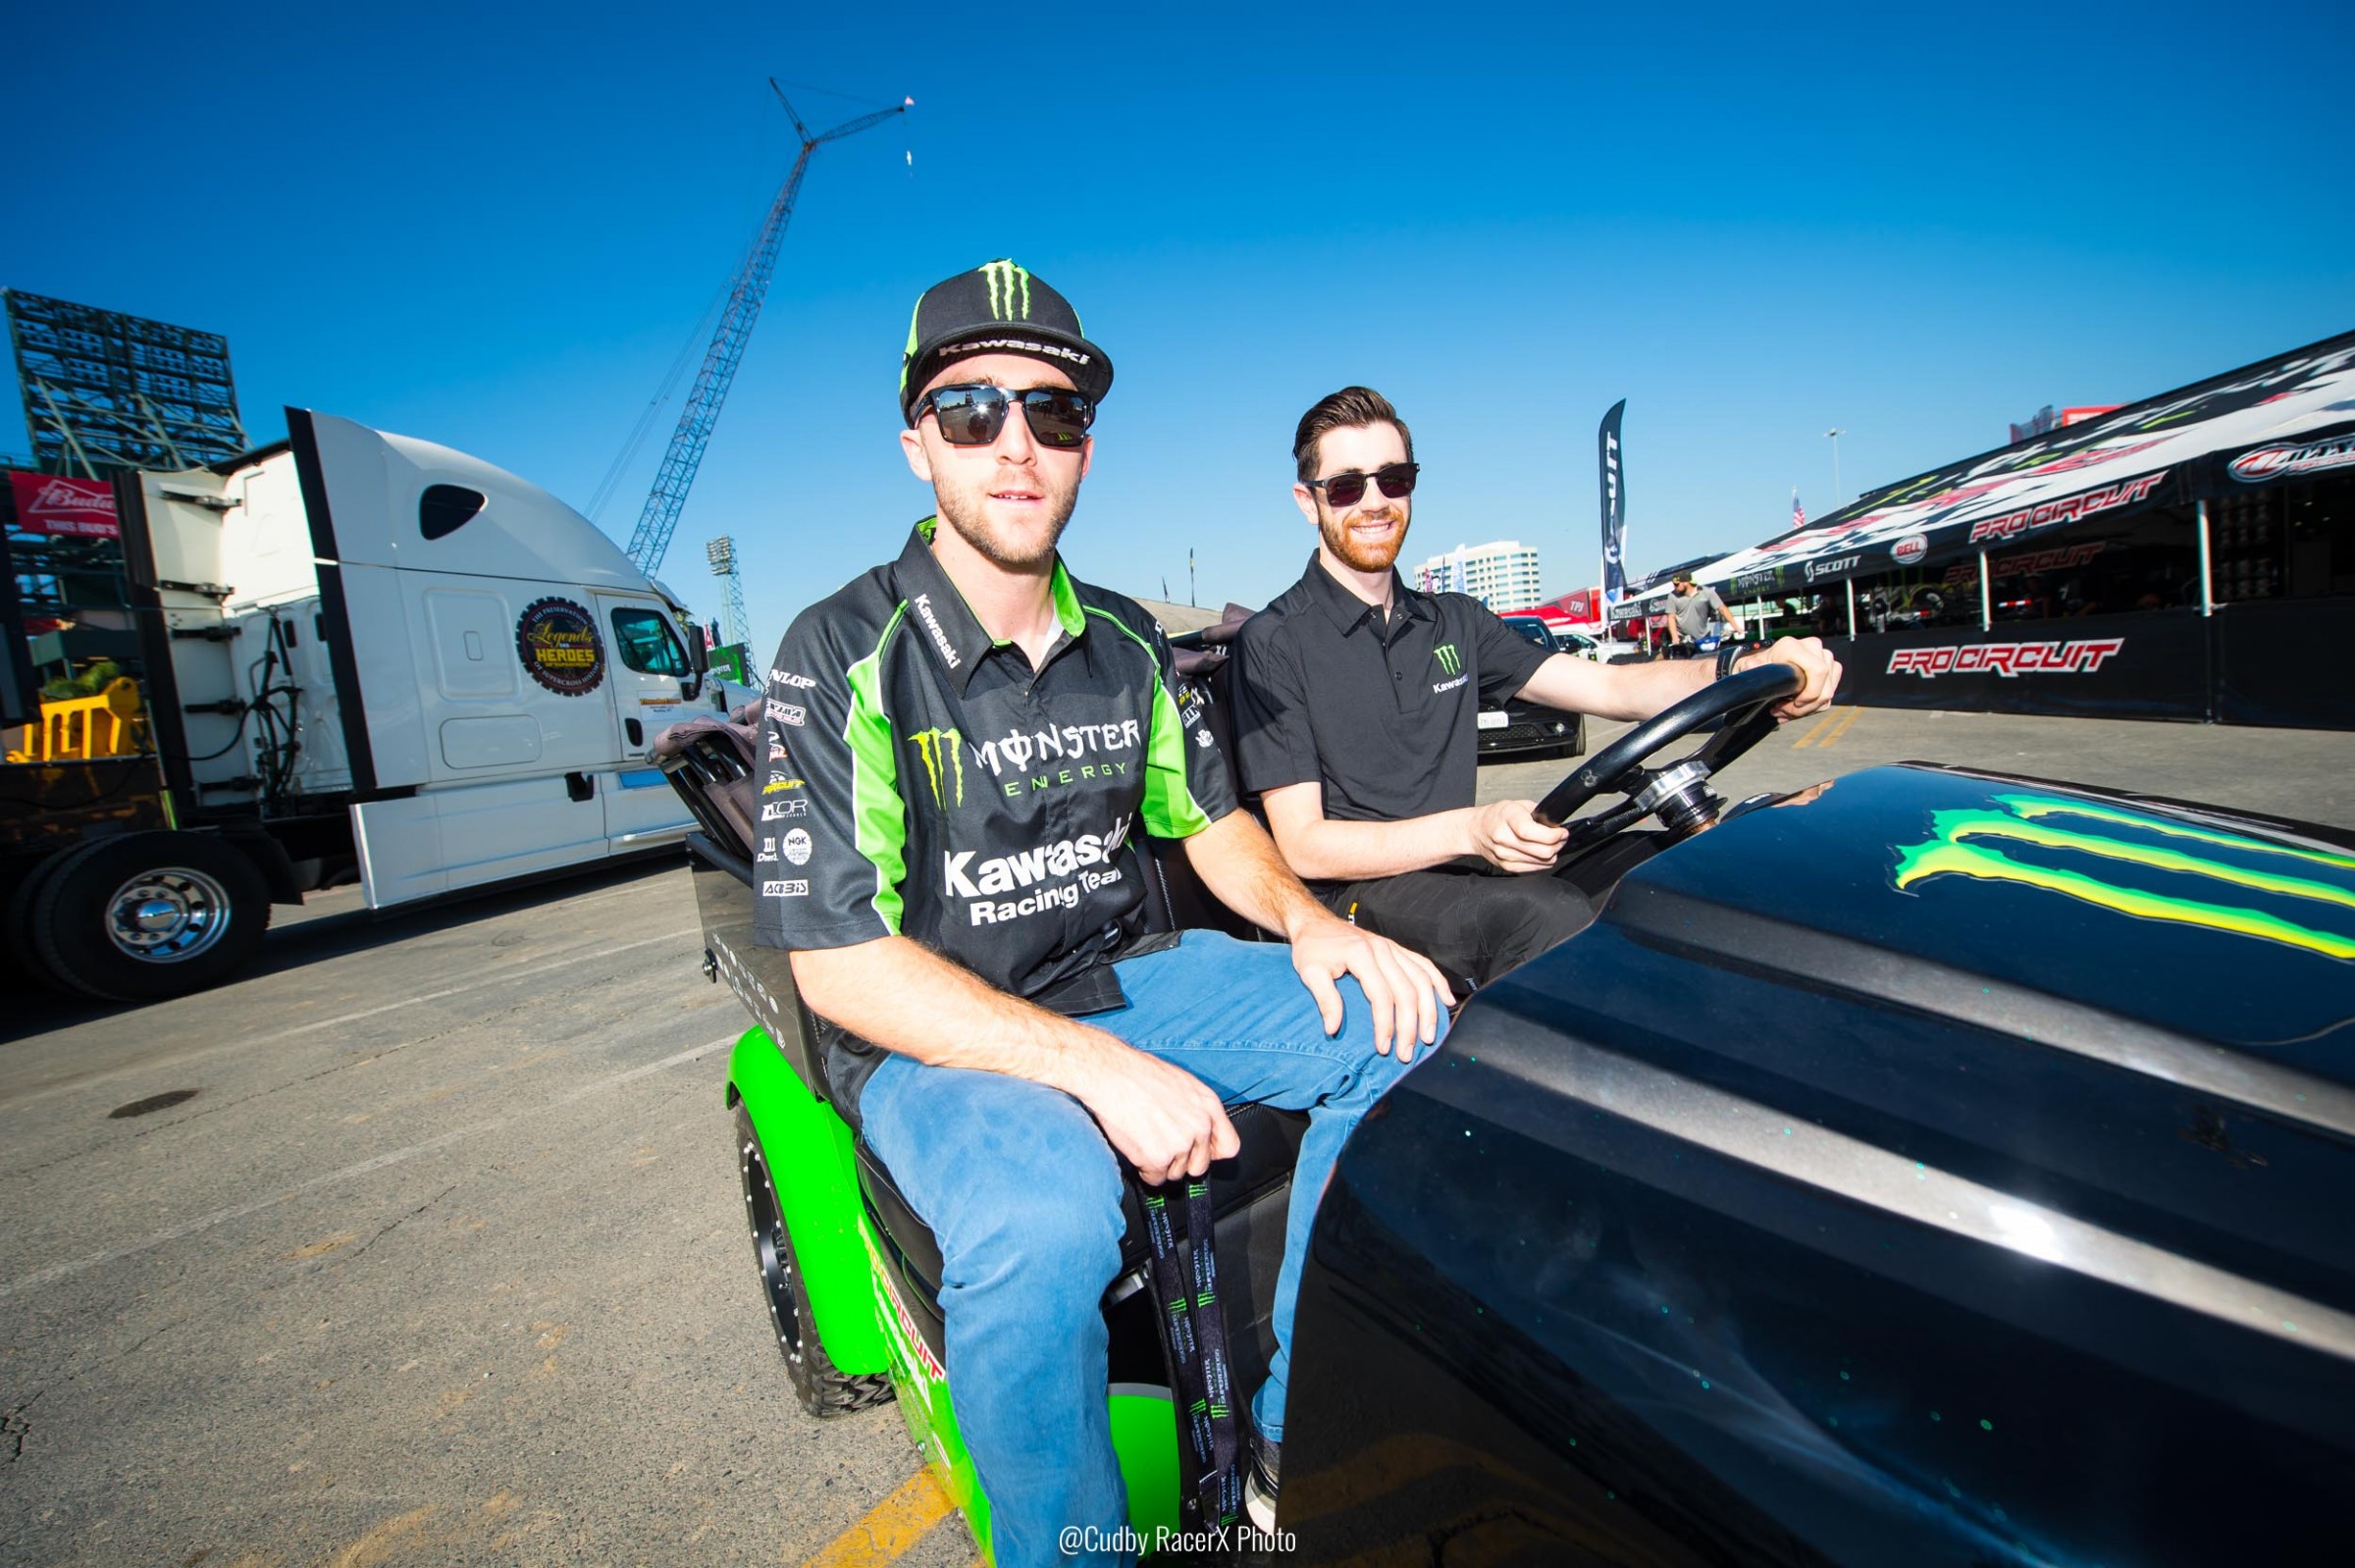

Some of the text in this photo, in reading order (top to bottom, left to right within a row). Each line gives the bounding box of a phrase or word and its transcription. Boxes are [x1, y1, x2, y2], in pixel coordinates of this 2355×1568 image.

[939, 339, 1091, 366] Kawasaki
[1968, 469, 2170, 544] PRO CIRCUIT
[1896, 541, 1921, 557] BELL
[1814, 554, 1862, 576] SCOTT
[1737, 570, 1776, 589] MONSTER
[532, 605, 589, 625] THE PRESERVATION
[527, 619, 594, 648] Legends
[914, 593, 962, 670] Kawasaki
[535, 648, 596, 662] HEROES
[1886, 638, 2125, 679] PRO CIRCUIT
[542, 668, 582, 686] SUPERCROSS
[581, 661, 601, 684] HISTORY
[968, 718, 1142, 776] MONSTER
[1003, 761, 1127, 798] ENERGY
[788, 836, 808, 847] NGK
[970, 866, 1123, 926] Racing Tea
[878, 1263, 947, 1385] CIRCUIT
